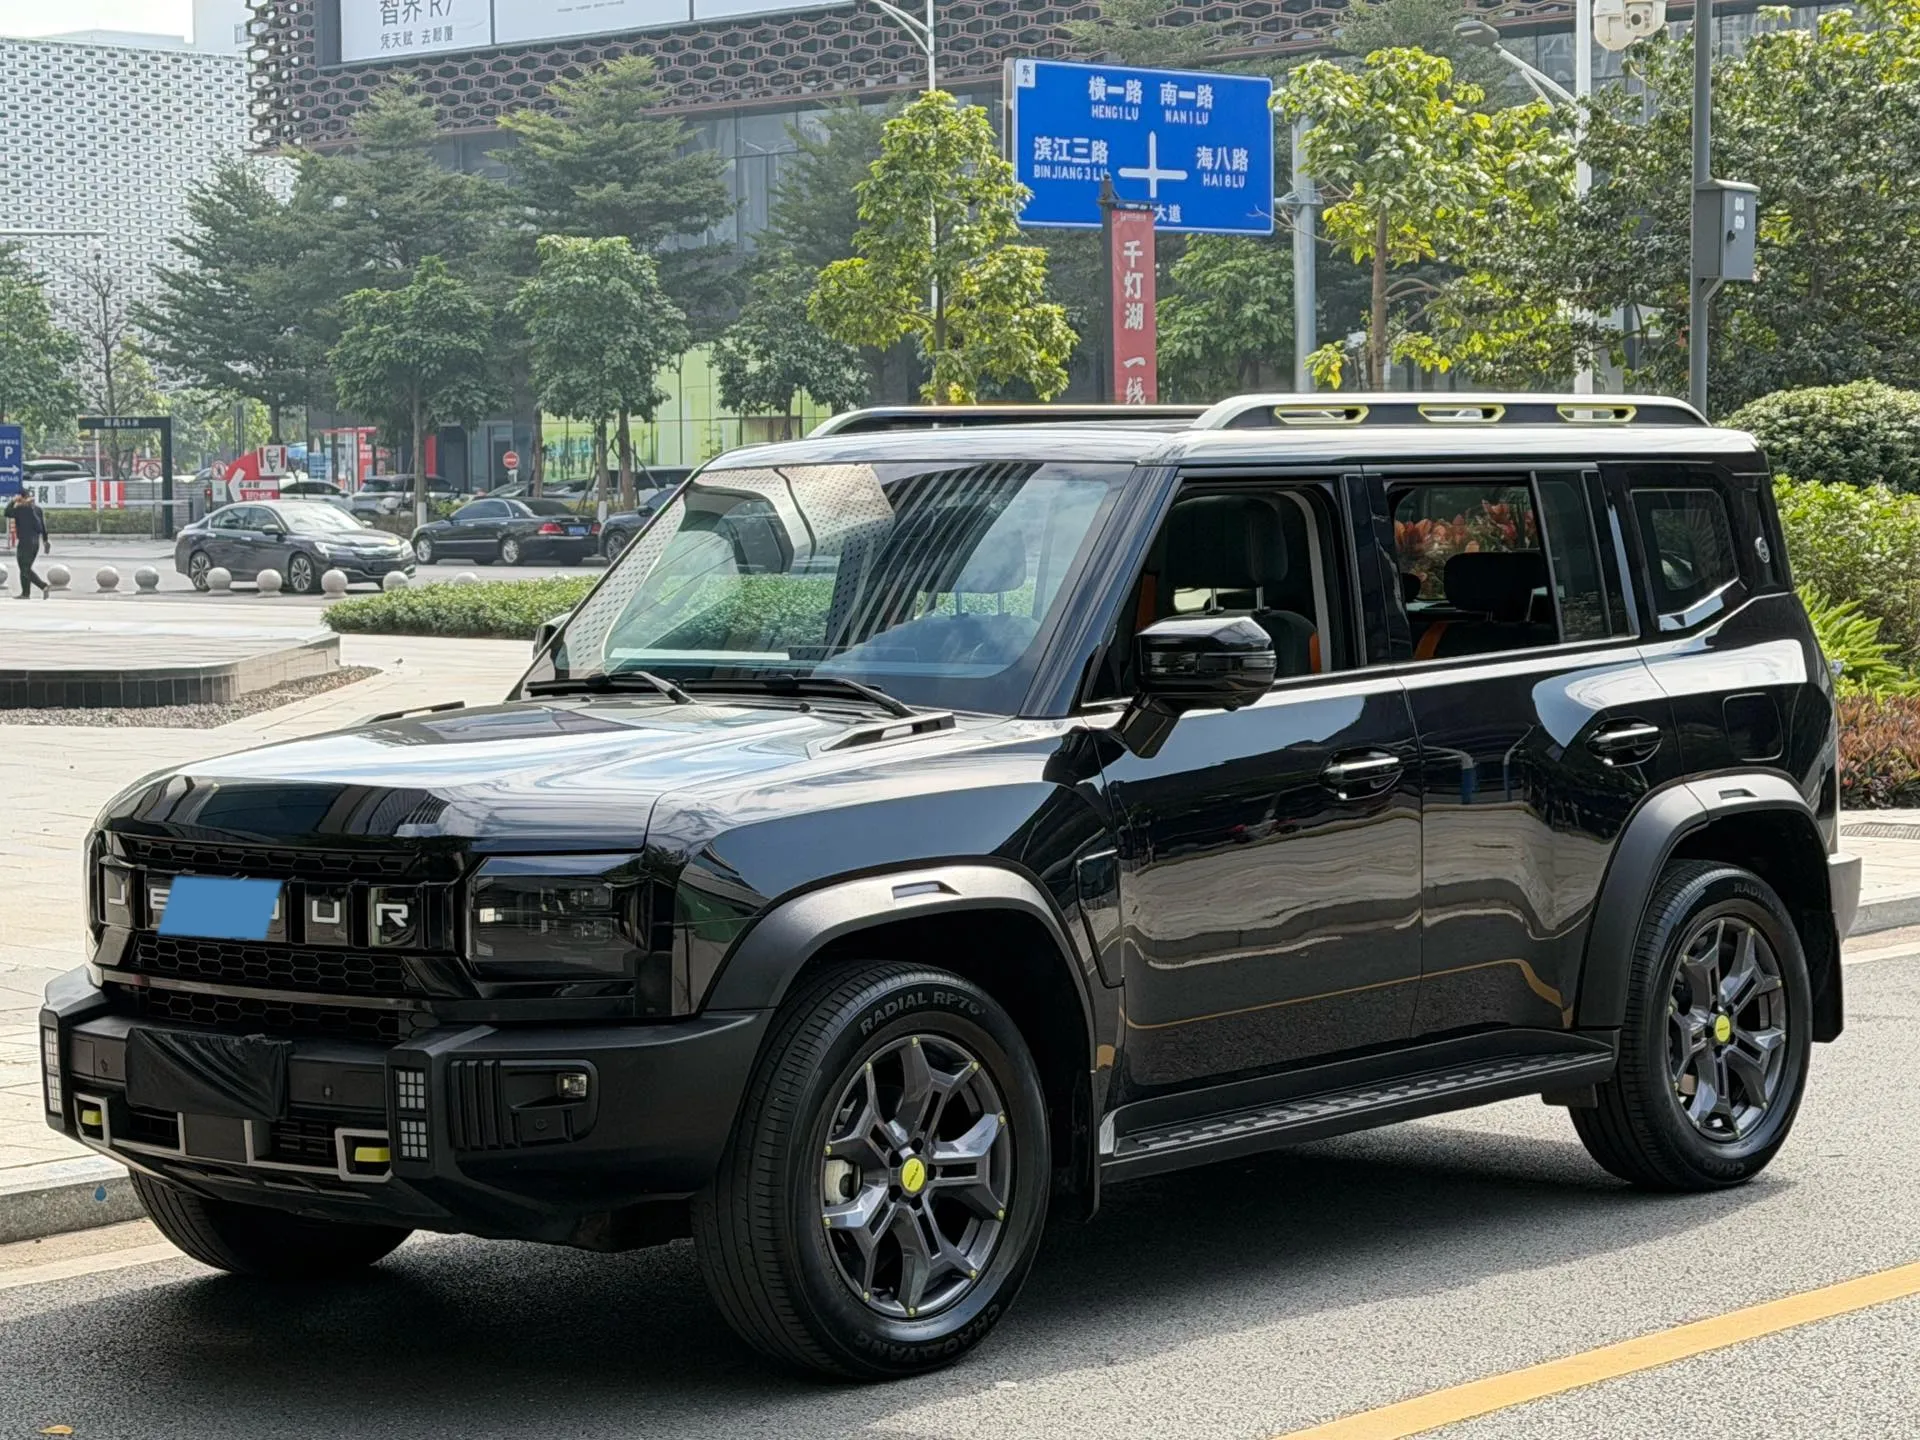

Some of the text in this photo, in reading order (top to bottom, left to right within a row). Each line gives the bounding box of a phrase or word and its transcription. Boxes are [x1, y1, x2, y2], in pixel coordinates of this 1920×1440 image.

[1088, 75, 1213, 109] 横一路 南一路
[1034, 136, 1108, 165] 滨江三路
[1196, 146, 1248, 171] 海八路
[1124, 240, 1144, 330] 千灯湖
[4, 446, 13, 459] P
[108, 883, 409, 928] JEUR
[860, 992, 928, 1035] RADIAL
